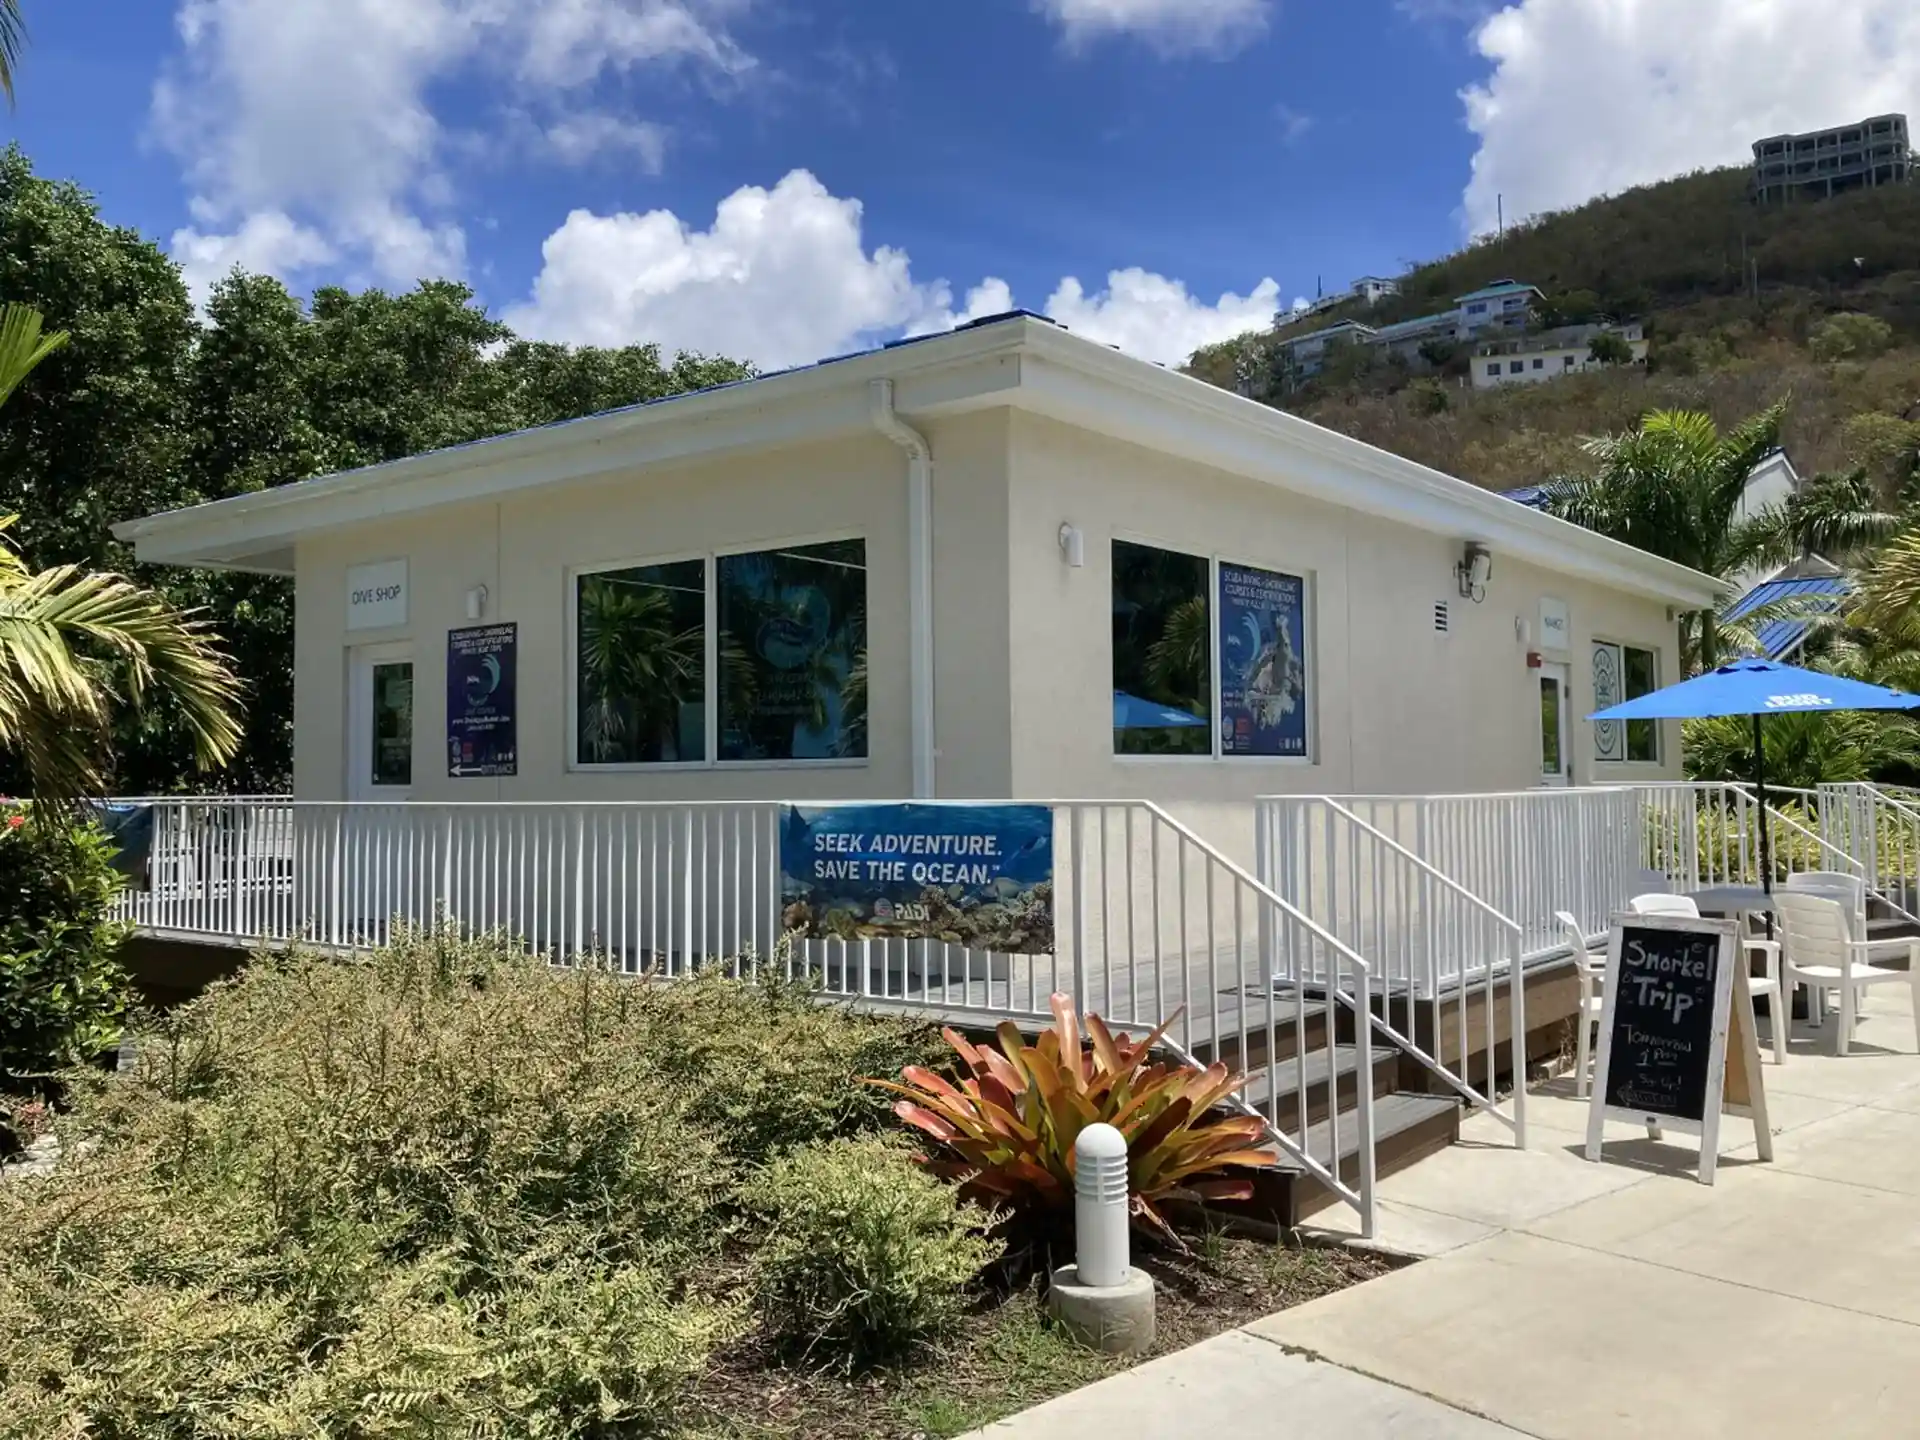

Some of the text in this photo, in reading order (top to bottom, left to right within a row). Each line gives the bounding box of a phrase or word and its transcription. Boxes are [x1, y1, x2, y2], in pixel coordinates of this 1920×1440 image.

[352, 584, 401, 605] DIVE SHOP
[814, 833, 1003, 856] SEEK ADVENTURE.
[814, 860, 860, 880] SAVE
[866, 862, 905, 882] THE
[894, 902, 930, 922] PADI
[1626, 940, 1716, 982] Snorkel
[1632, 975, 1694, 1025] Trip
